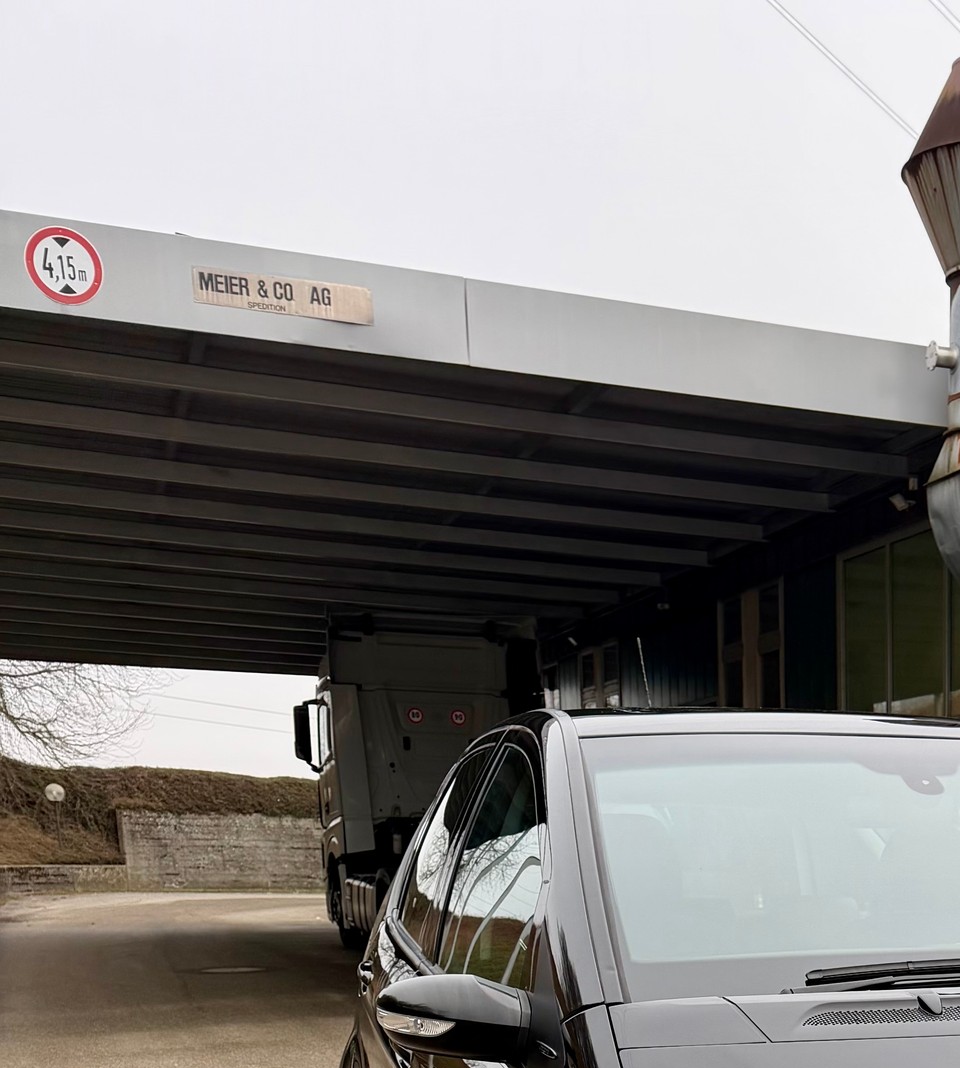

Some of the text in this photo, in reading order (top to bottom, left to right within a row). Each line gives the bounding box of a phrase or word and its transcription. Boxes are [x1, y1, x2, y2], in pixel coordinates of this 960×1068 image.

[198, 271, 332, 306] MEIER & CO AG
[247, 301, 286, 312] SPEDITION
